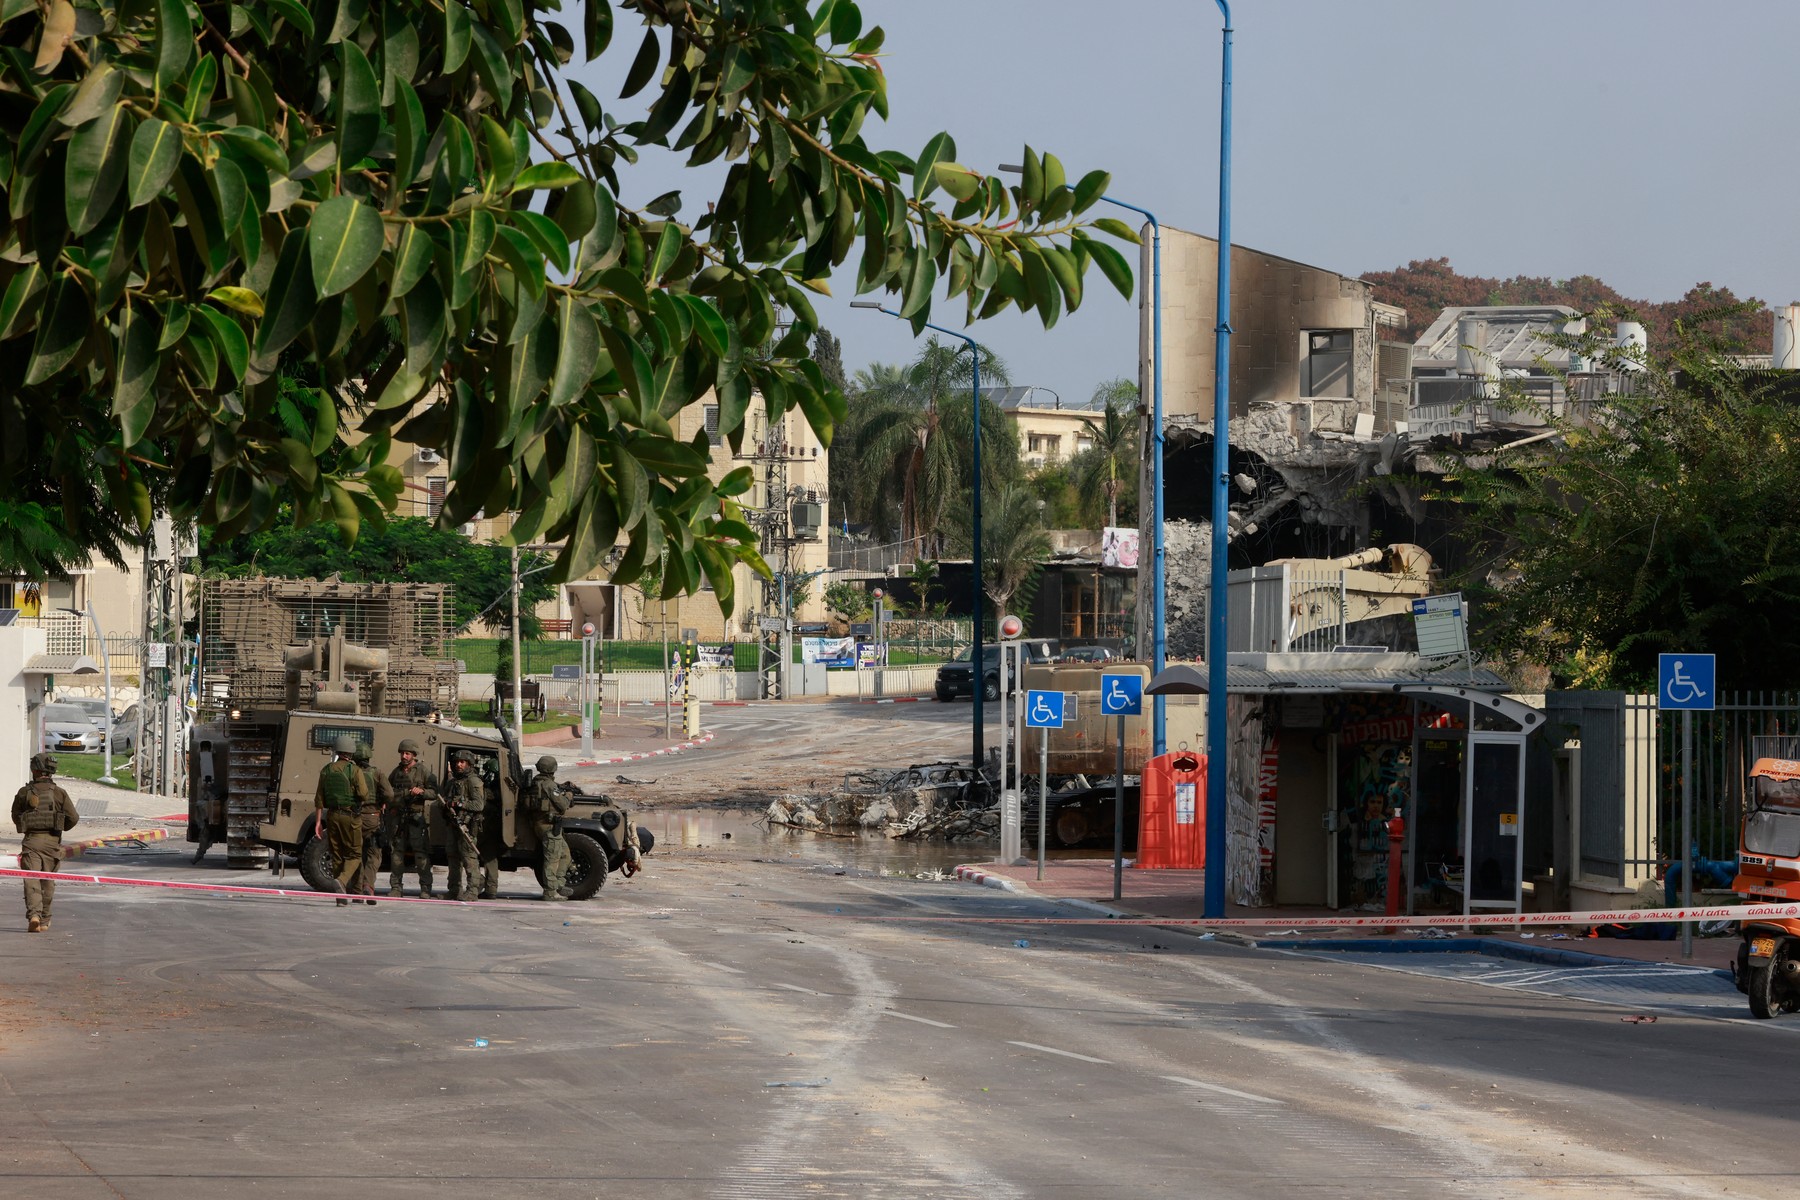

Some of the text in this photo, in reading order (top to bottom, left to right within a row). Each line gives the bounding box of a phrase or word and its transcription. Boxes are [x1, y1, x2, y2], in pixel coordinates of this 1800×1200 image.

[1343, 719, 1409, 745] מהפכה
[1506, 815, 1512, 823] 5
[1741, 856, 1763, 864] 889
[1748, 907, 1784, 915] משטרת
